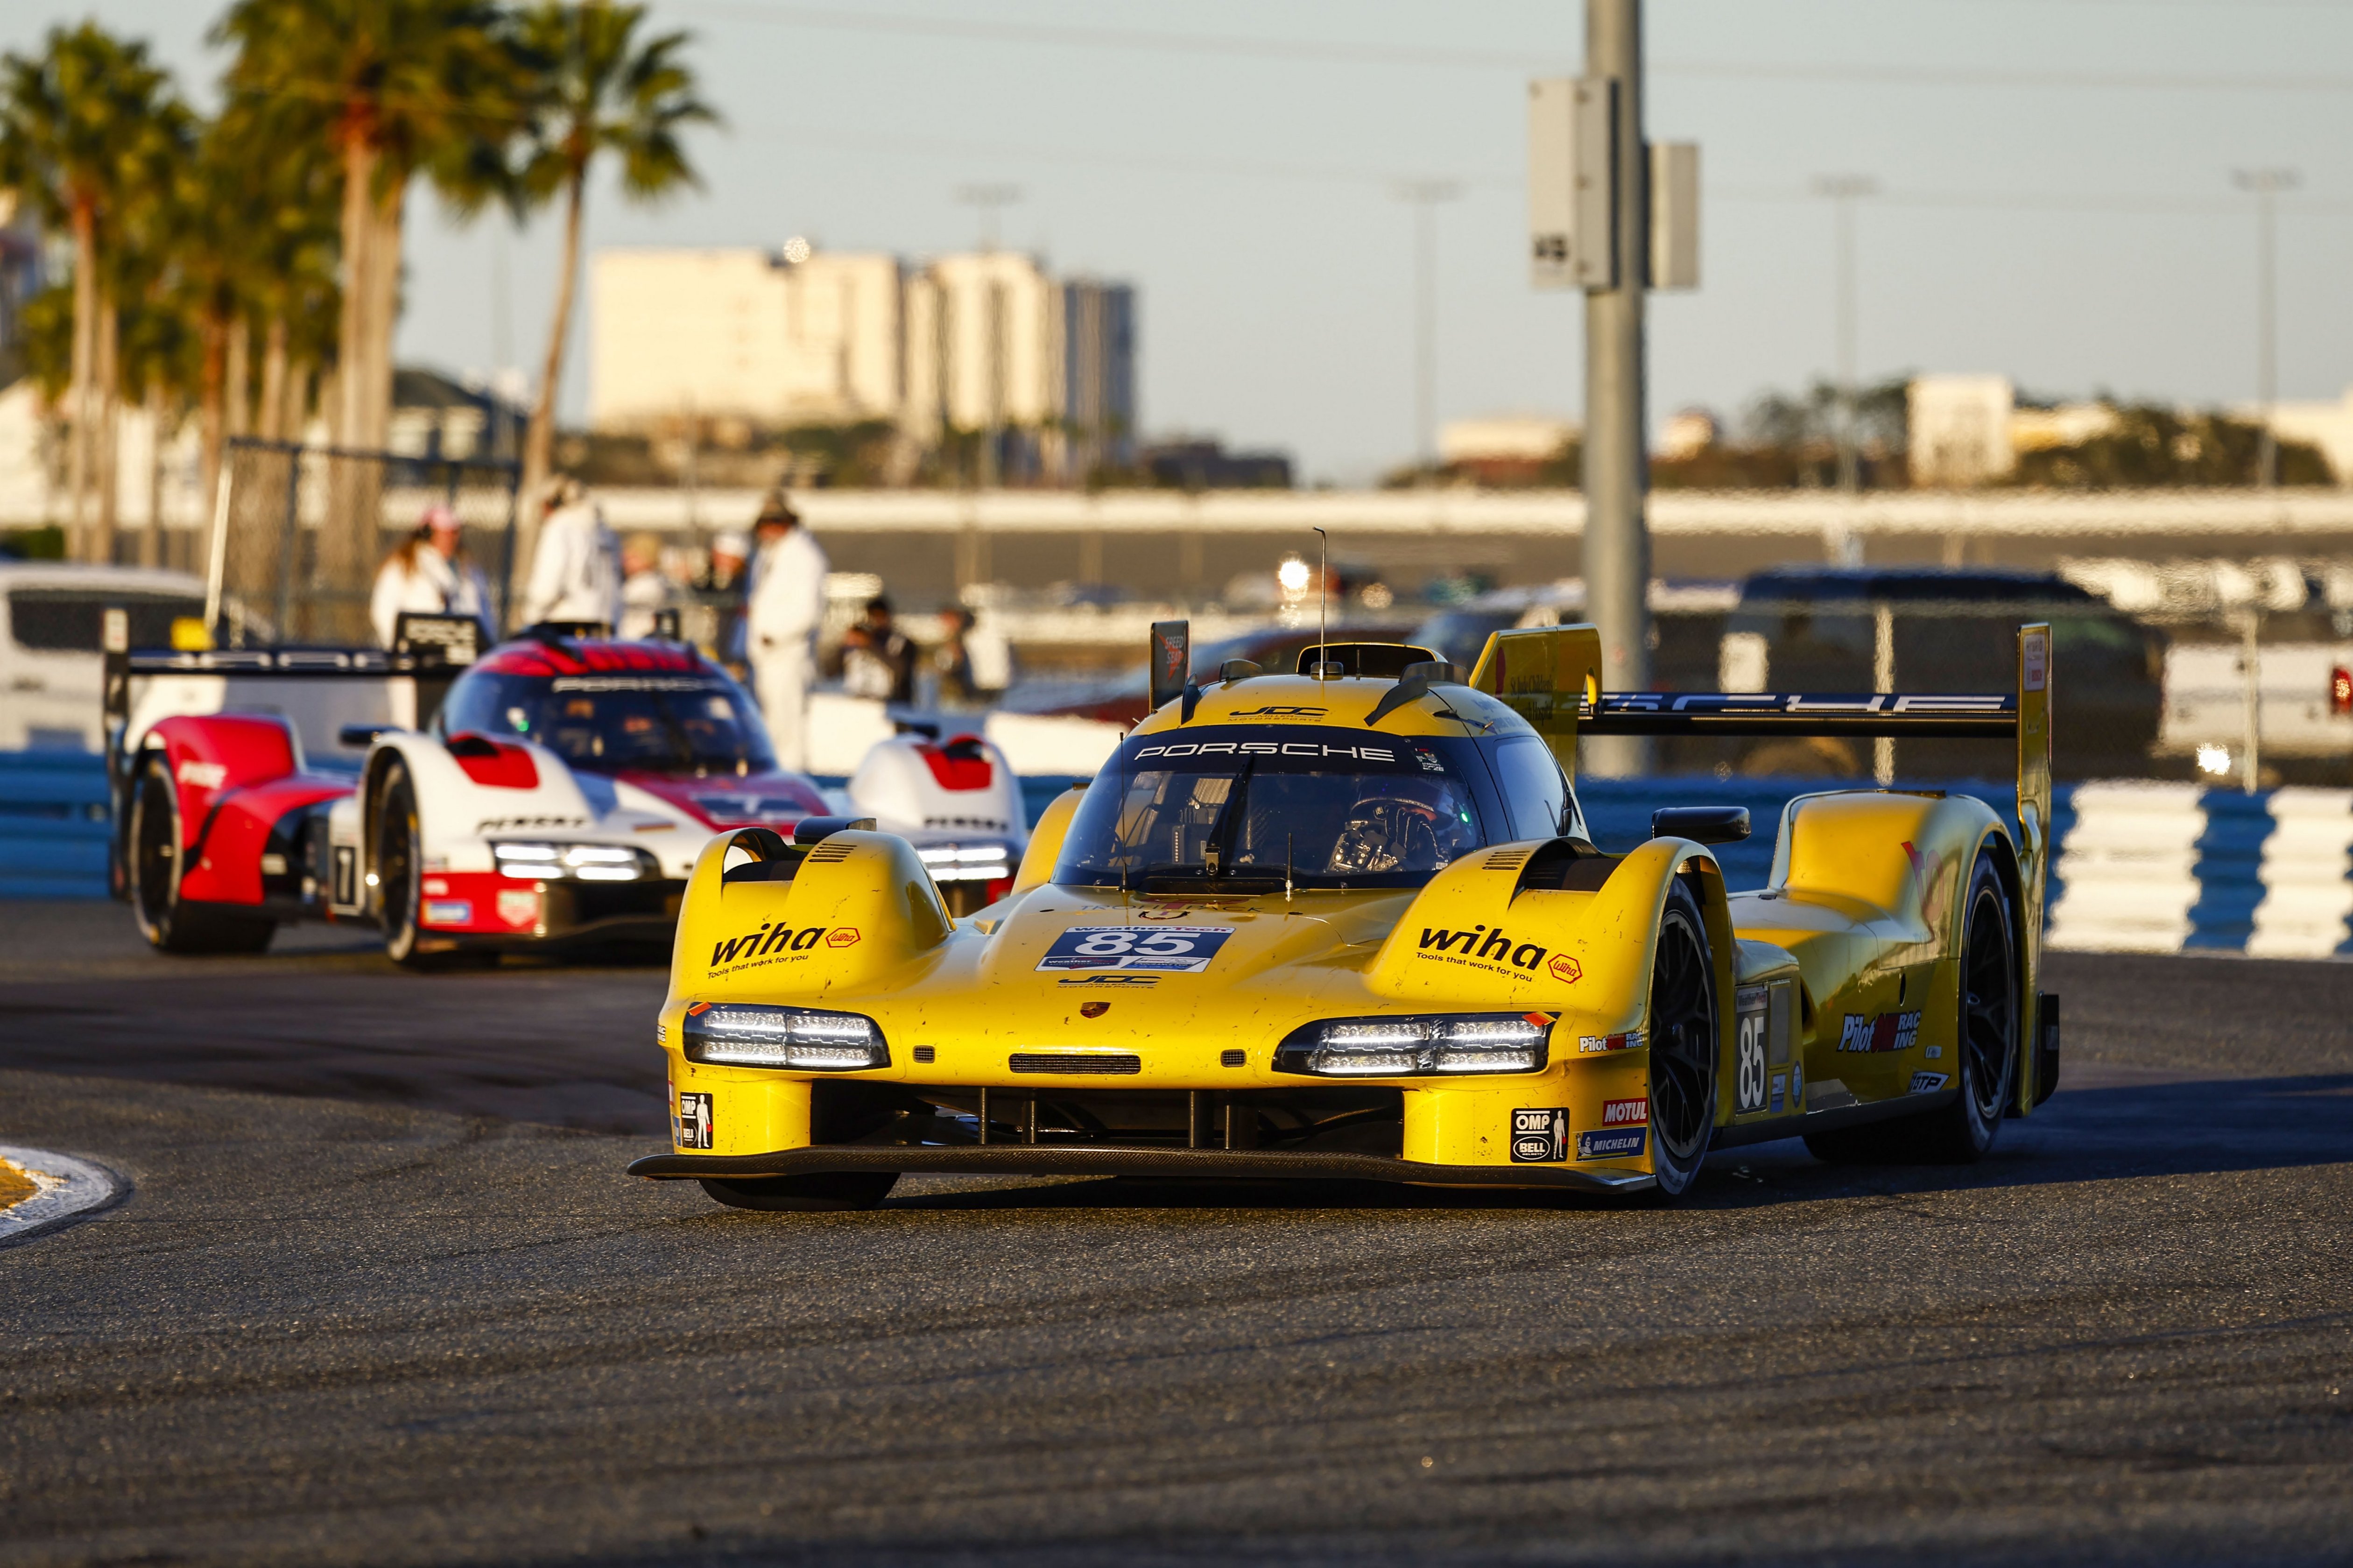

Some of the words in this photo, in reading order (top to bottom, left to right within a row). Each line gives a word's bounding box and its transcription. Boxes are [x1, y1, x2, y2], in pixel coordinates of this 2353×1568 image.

[1165, 636, 1184, 649] SPEED
[1229, 706, 1329, 716] JDC
[1134, 742, 1395, 762] PORSCHE
[710, 921, 827, 967] wiha
[1075, 932, 1201, 956] 85
[1418, 925, 1548, 971] wiha
[1553, 960, 1577, 977] Wiha
[708, 967, 729, 979] Tools
[732, 963, 749, 972] that
[751, 958, 773, 968] work
[790, 954, 809, 963] you
[1416, 952, 1444, 962] Tools
[1446, 956, 1467, 966] that
[1469, 961, 1494, 972] work
[1496, 966, 1511, 976] for
[1513, 971, 1533, 982] you
[1897, 1012, 1921, 1030] RAC
[1626, 1032, 1643, 1041] RAC
[1838, 1015, 1875, 1052] Pilot
[1894, 1031, 1917, 1049] ING
[1579, 1036, 1607, 1052] Pilot
[1626, 1040, 1643, 1048] ING
[1740, 1016, 1764, 1109] 85
[681, 1100, 696, 1114] OMP
[1604, 1102, 1647, 1122] MOTUL
[1515, 1115, 1550, 1130] OMP
[1519, 1143, 1545, 1153] BELL
[1593, 1137, 1640, 1151] MICHELIN
